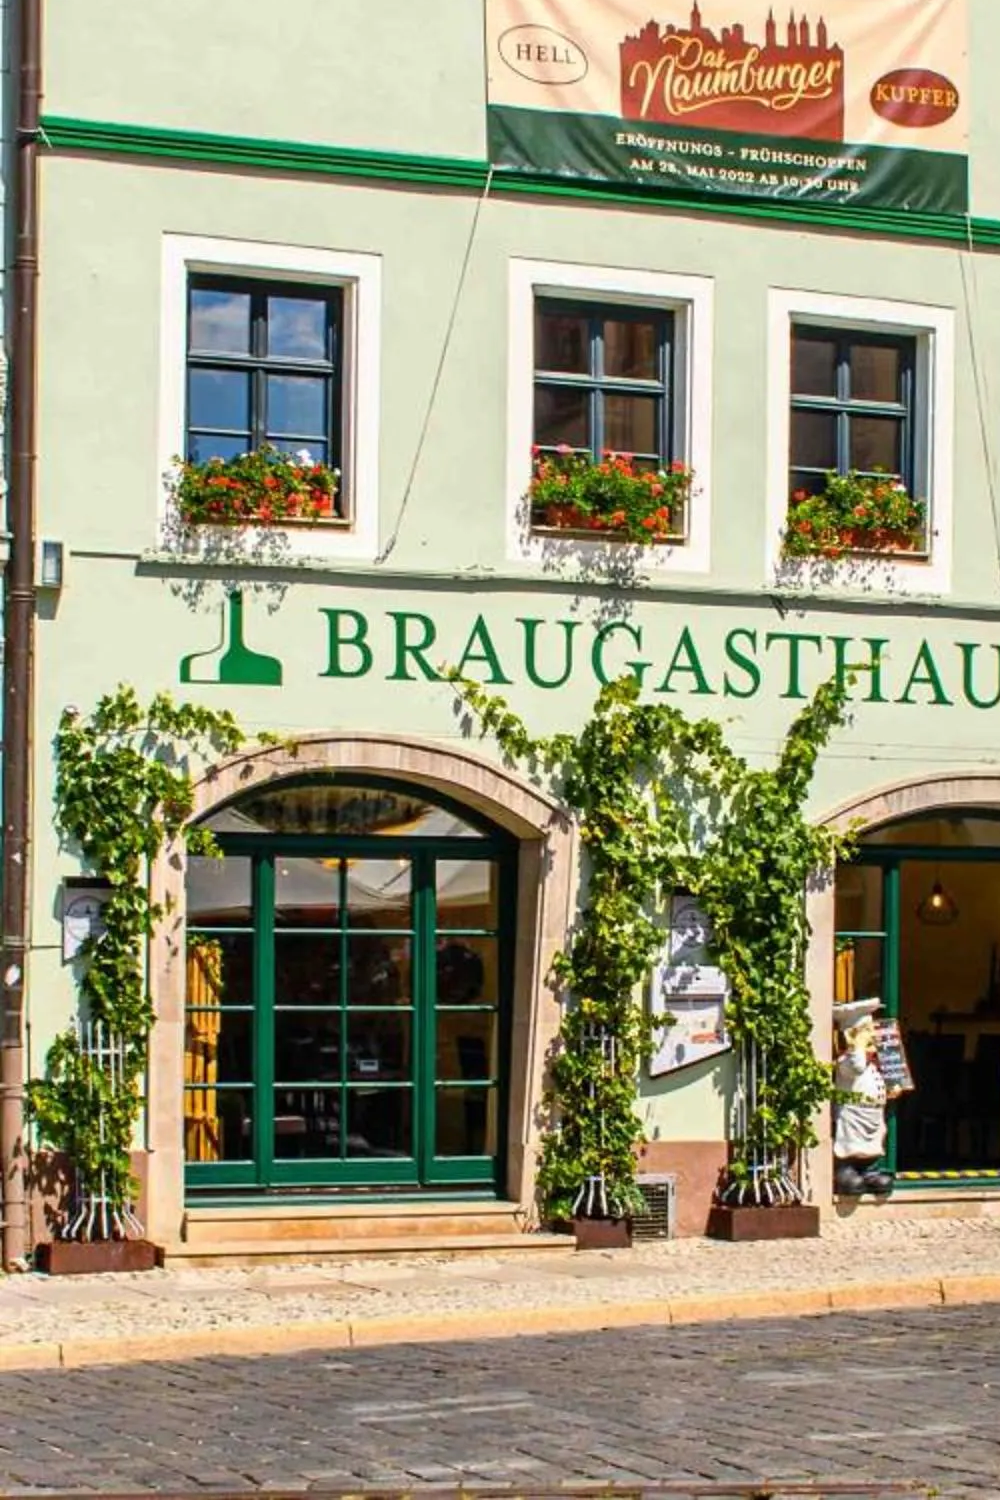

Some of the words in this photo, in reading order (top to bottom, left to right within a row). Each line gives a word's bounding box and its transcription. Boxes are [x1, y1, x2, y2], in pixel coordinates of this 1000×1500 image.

[516, 43, 576, 65] HELL
[662, 34, 727, 71] Das
[629, 47, 841, 118] Naumburger
[876, 83, 957, 107] KUPFER
[740, 147, 867, 172] FRÜHSCHOPPEN
[629, 158, 653, 171] AM
[686, 164, 715, 179] MAI
[719, 168, 755, 183] 2022
[760, 173, 779, 185] AB
[828, 179, 860, 194] UHR
